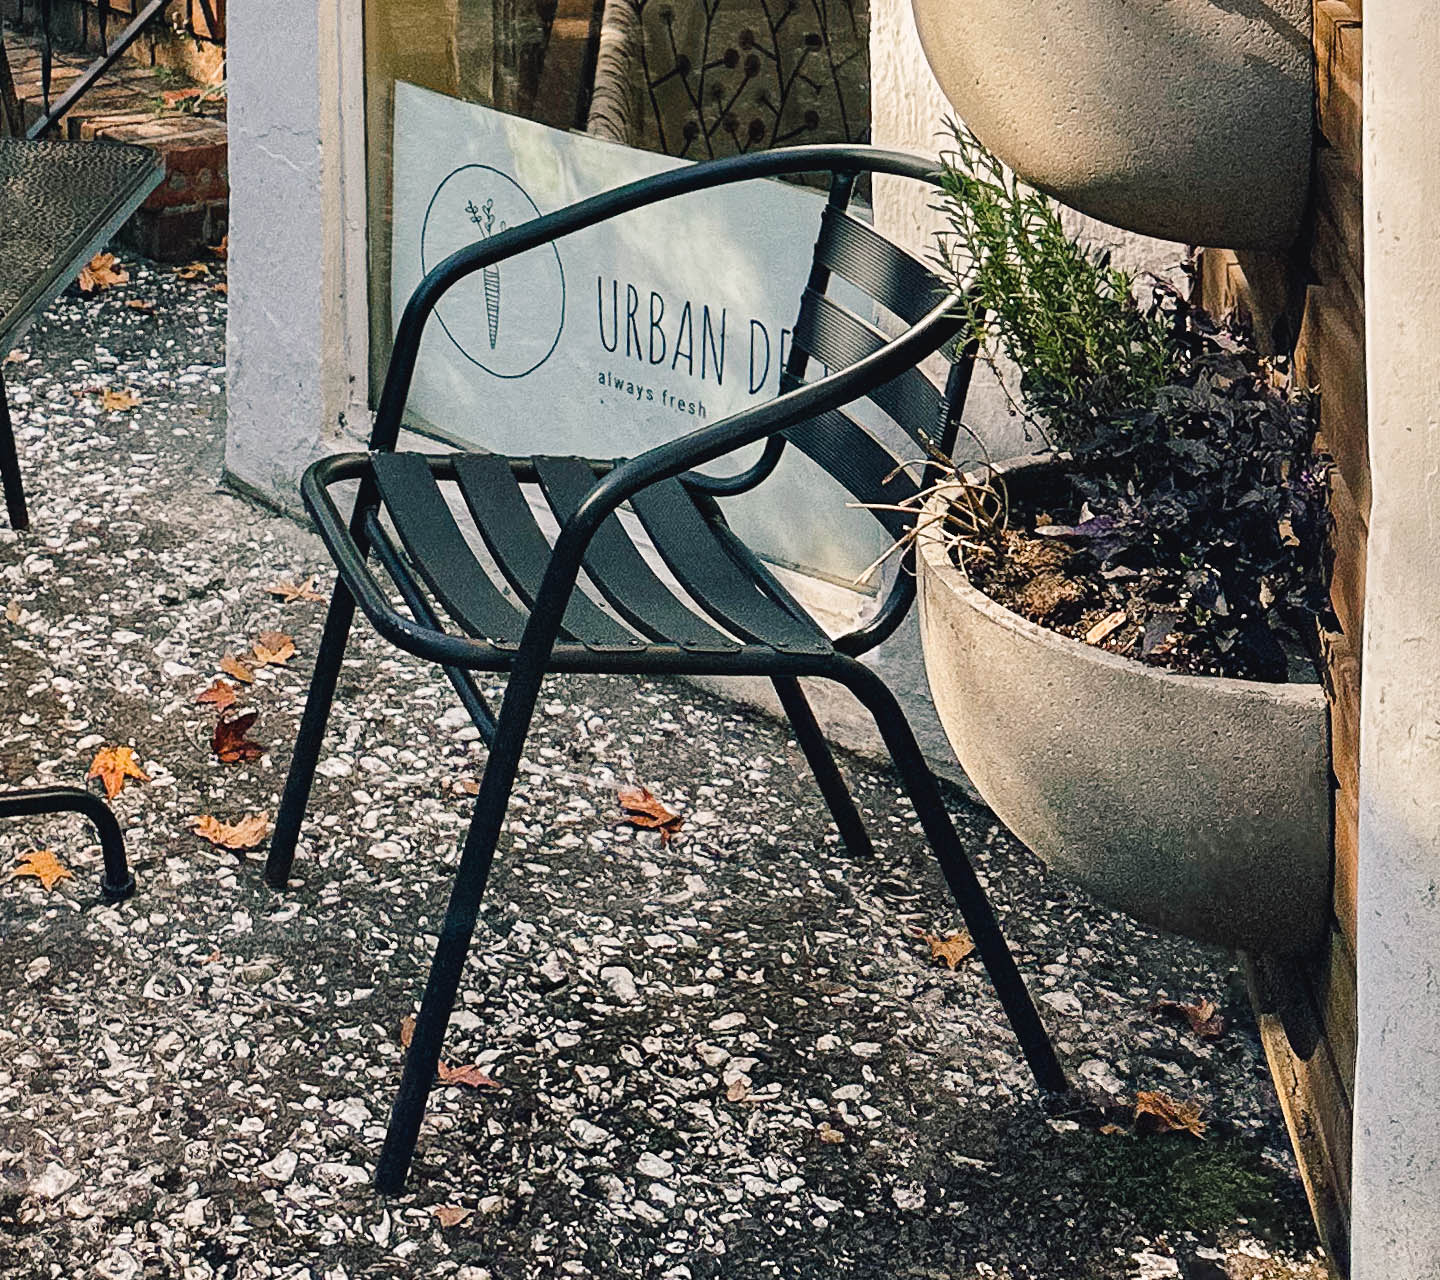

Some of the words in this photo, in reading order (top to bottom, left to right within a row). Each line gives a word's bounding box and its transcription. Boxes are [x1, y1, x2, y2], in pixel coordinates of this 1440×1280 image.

[597, 275, 726, 385] URBAN
[598, 371, 654, 401] always
[662, 389, 706, 419] fresh
